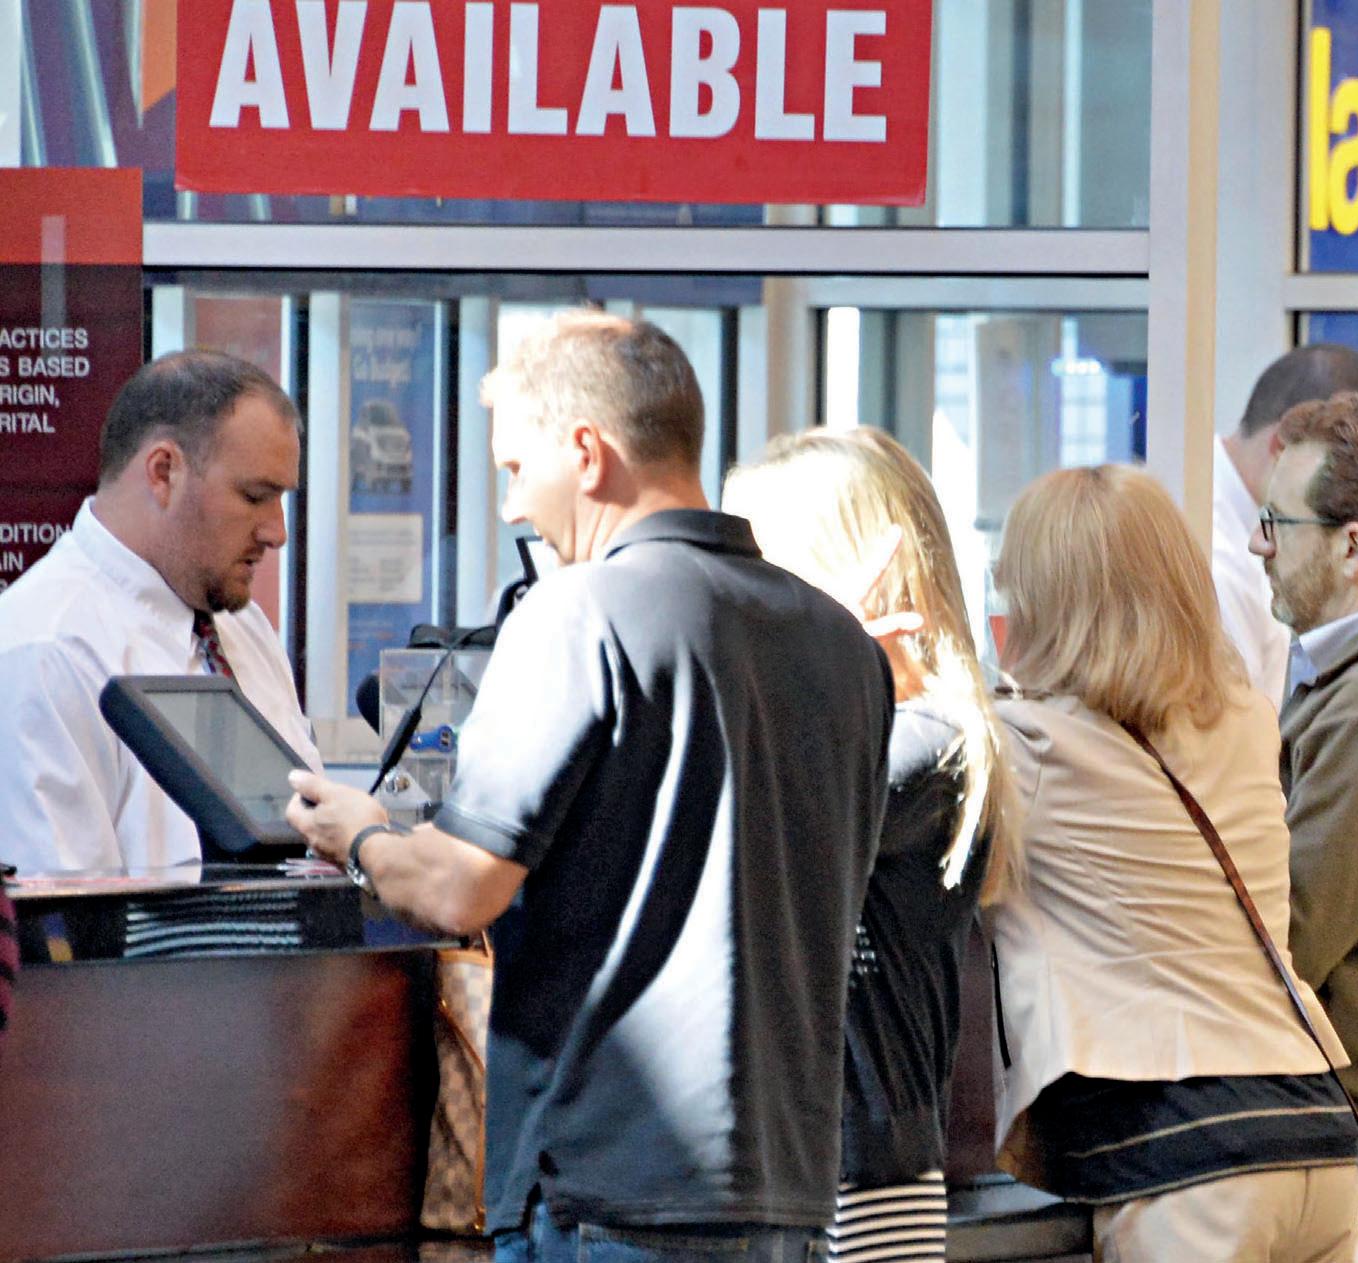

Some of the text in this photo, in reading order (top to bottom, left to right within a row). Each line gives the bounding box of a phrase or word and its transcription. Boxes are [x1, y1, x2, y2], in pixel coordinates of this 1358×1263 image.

[210, 0, 887, 142] AVAILABLE
[0, 327, 89, 349] ACTICES
[18, 355, 90, 377] BASED
[0, 384, 60, 407] RIGIN,
[0, 412, 55, 434] RITAL
[0, 552, 23, 571] IN
